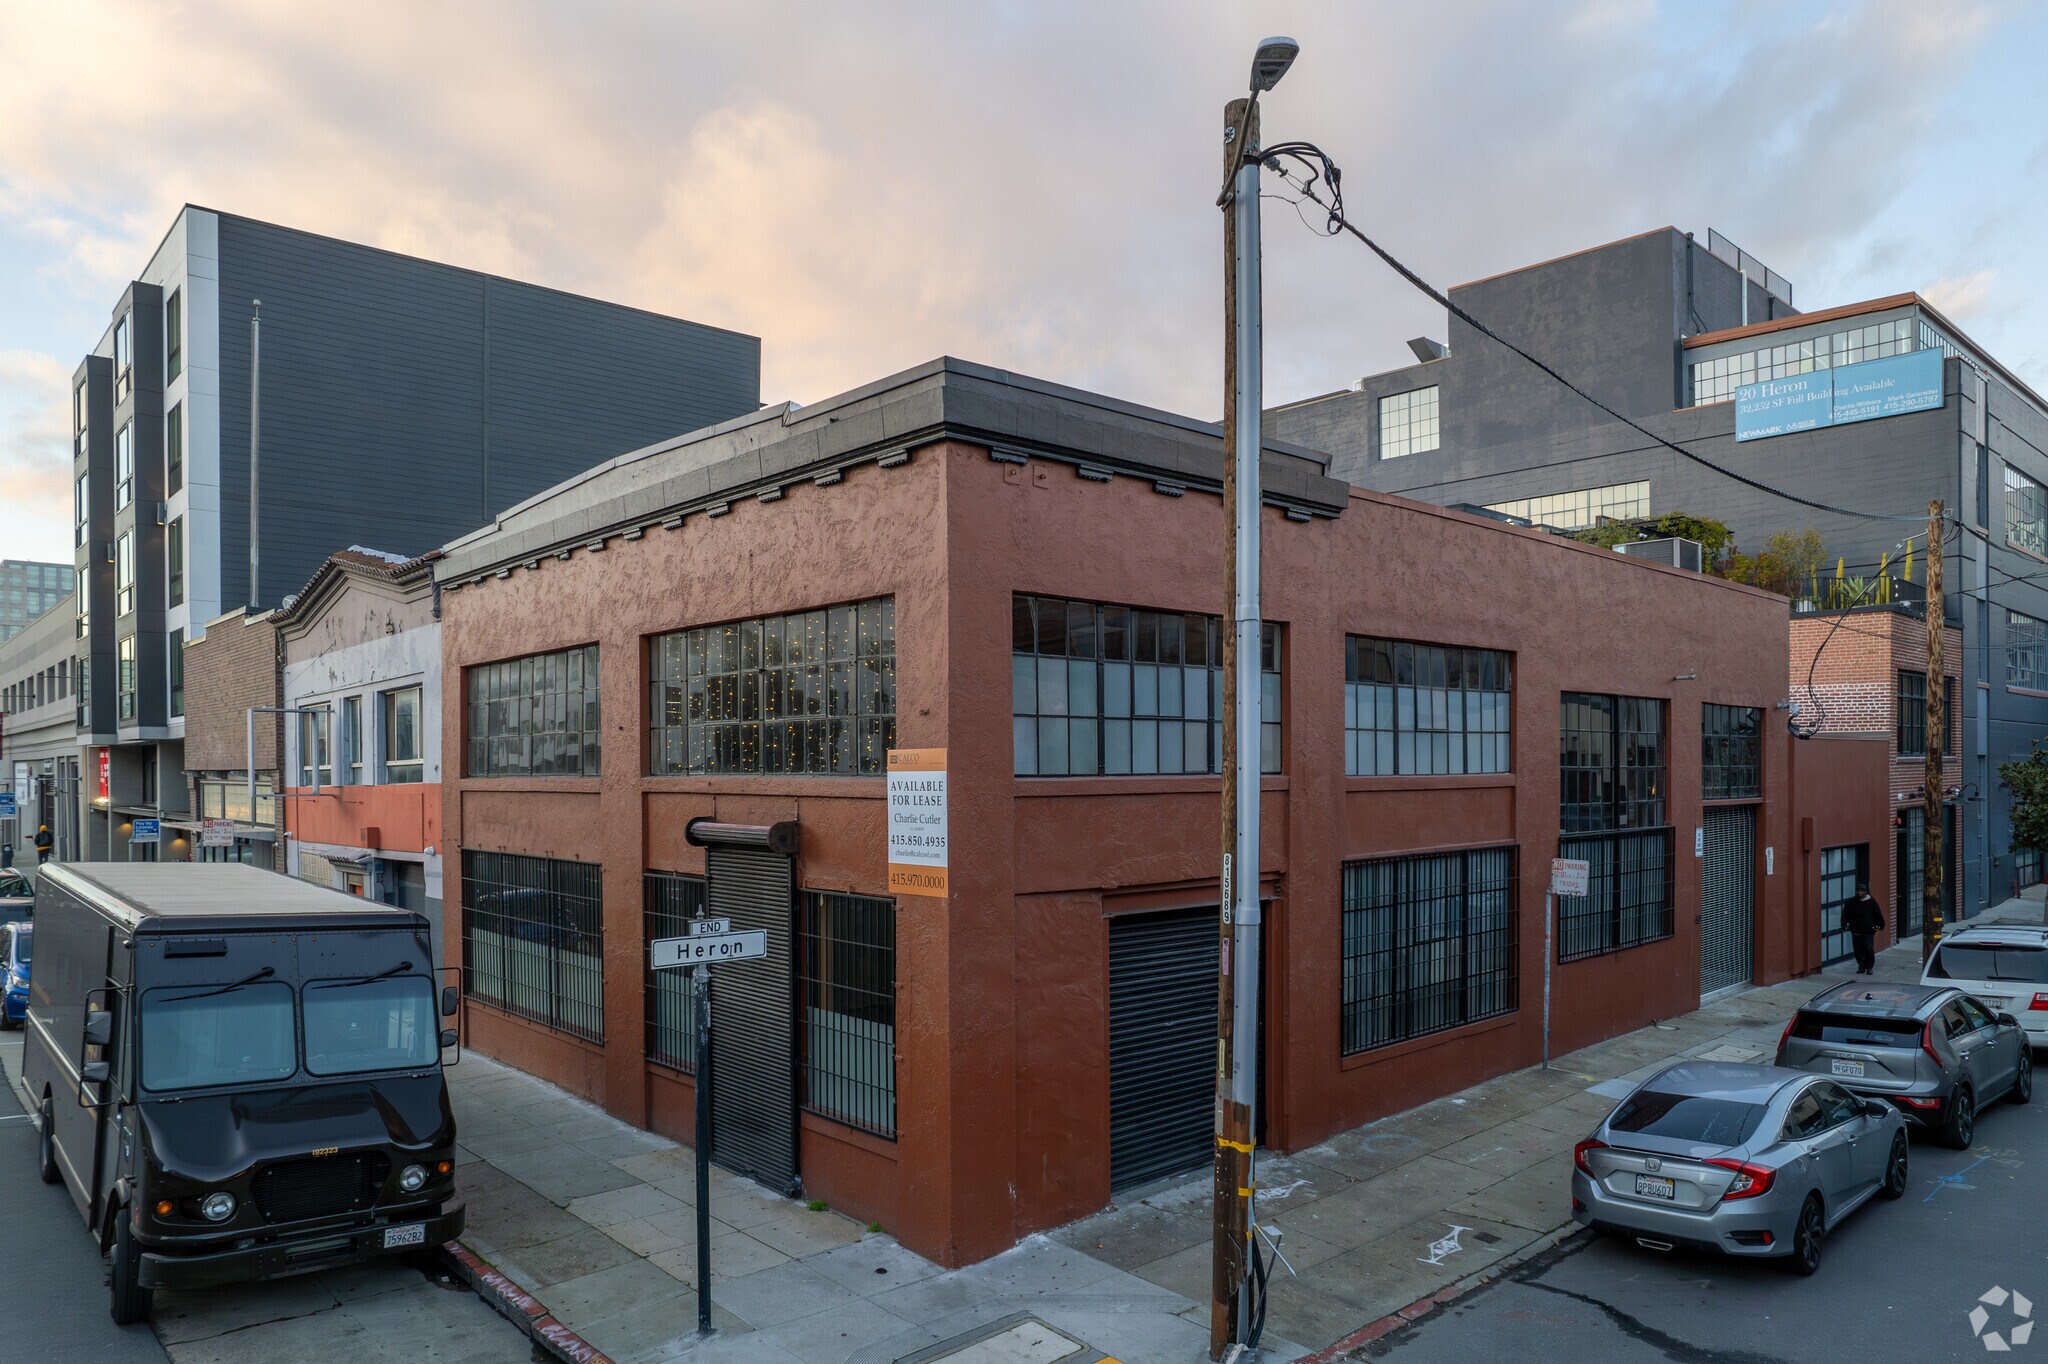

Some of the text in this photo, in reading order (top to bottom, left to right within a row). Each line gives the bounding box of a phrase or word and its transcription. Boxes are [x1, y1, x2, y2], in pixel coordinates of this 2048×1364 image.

[1739, 380, 1807, 402] 20 Heron
[1772, 398, 1784, 408] SF
[1787, 395, 1804, 405] Full
[1807, 387, 1848, 401] Building
[1851, 378, 1895, 393] Available
[1739, 425, 1782, 439] NEWMARK
[898, 752, 920, 762] CALCO
[891, 780, 943, 792] AVAILABLE
[892, 794, 942, 807] FOR LEASE
[894, 812, 941, 825] Charlie Cutler
[891, 834, 945, 848] 415.850.4935
[1553, 860, 1587, 871] NO PARKING
[891, 872, 945, 890] 415.970.0000
[701, 922, 721, 933] END
[678, 942, 742, 959] Heron
[312, 1147, 339, 1156] 192323
[387, 1231, 423, 1246] 75962B2
